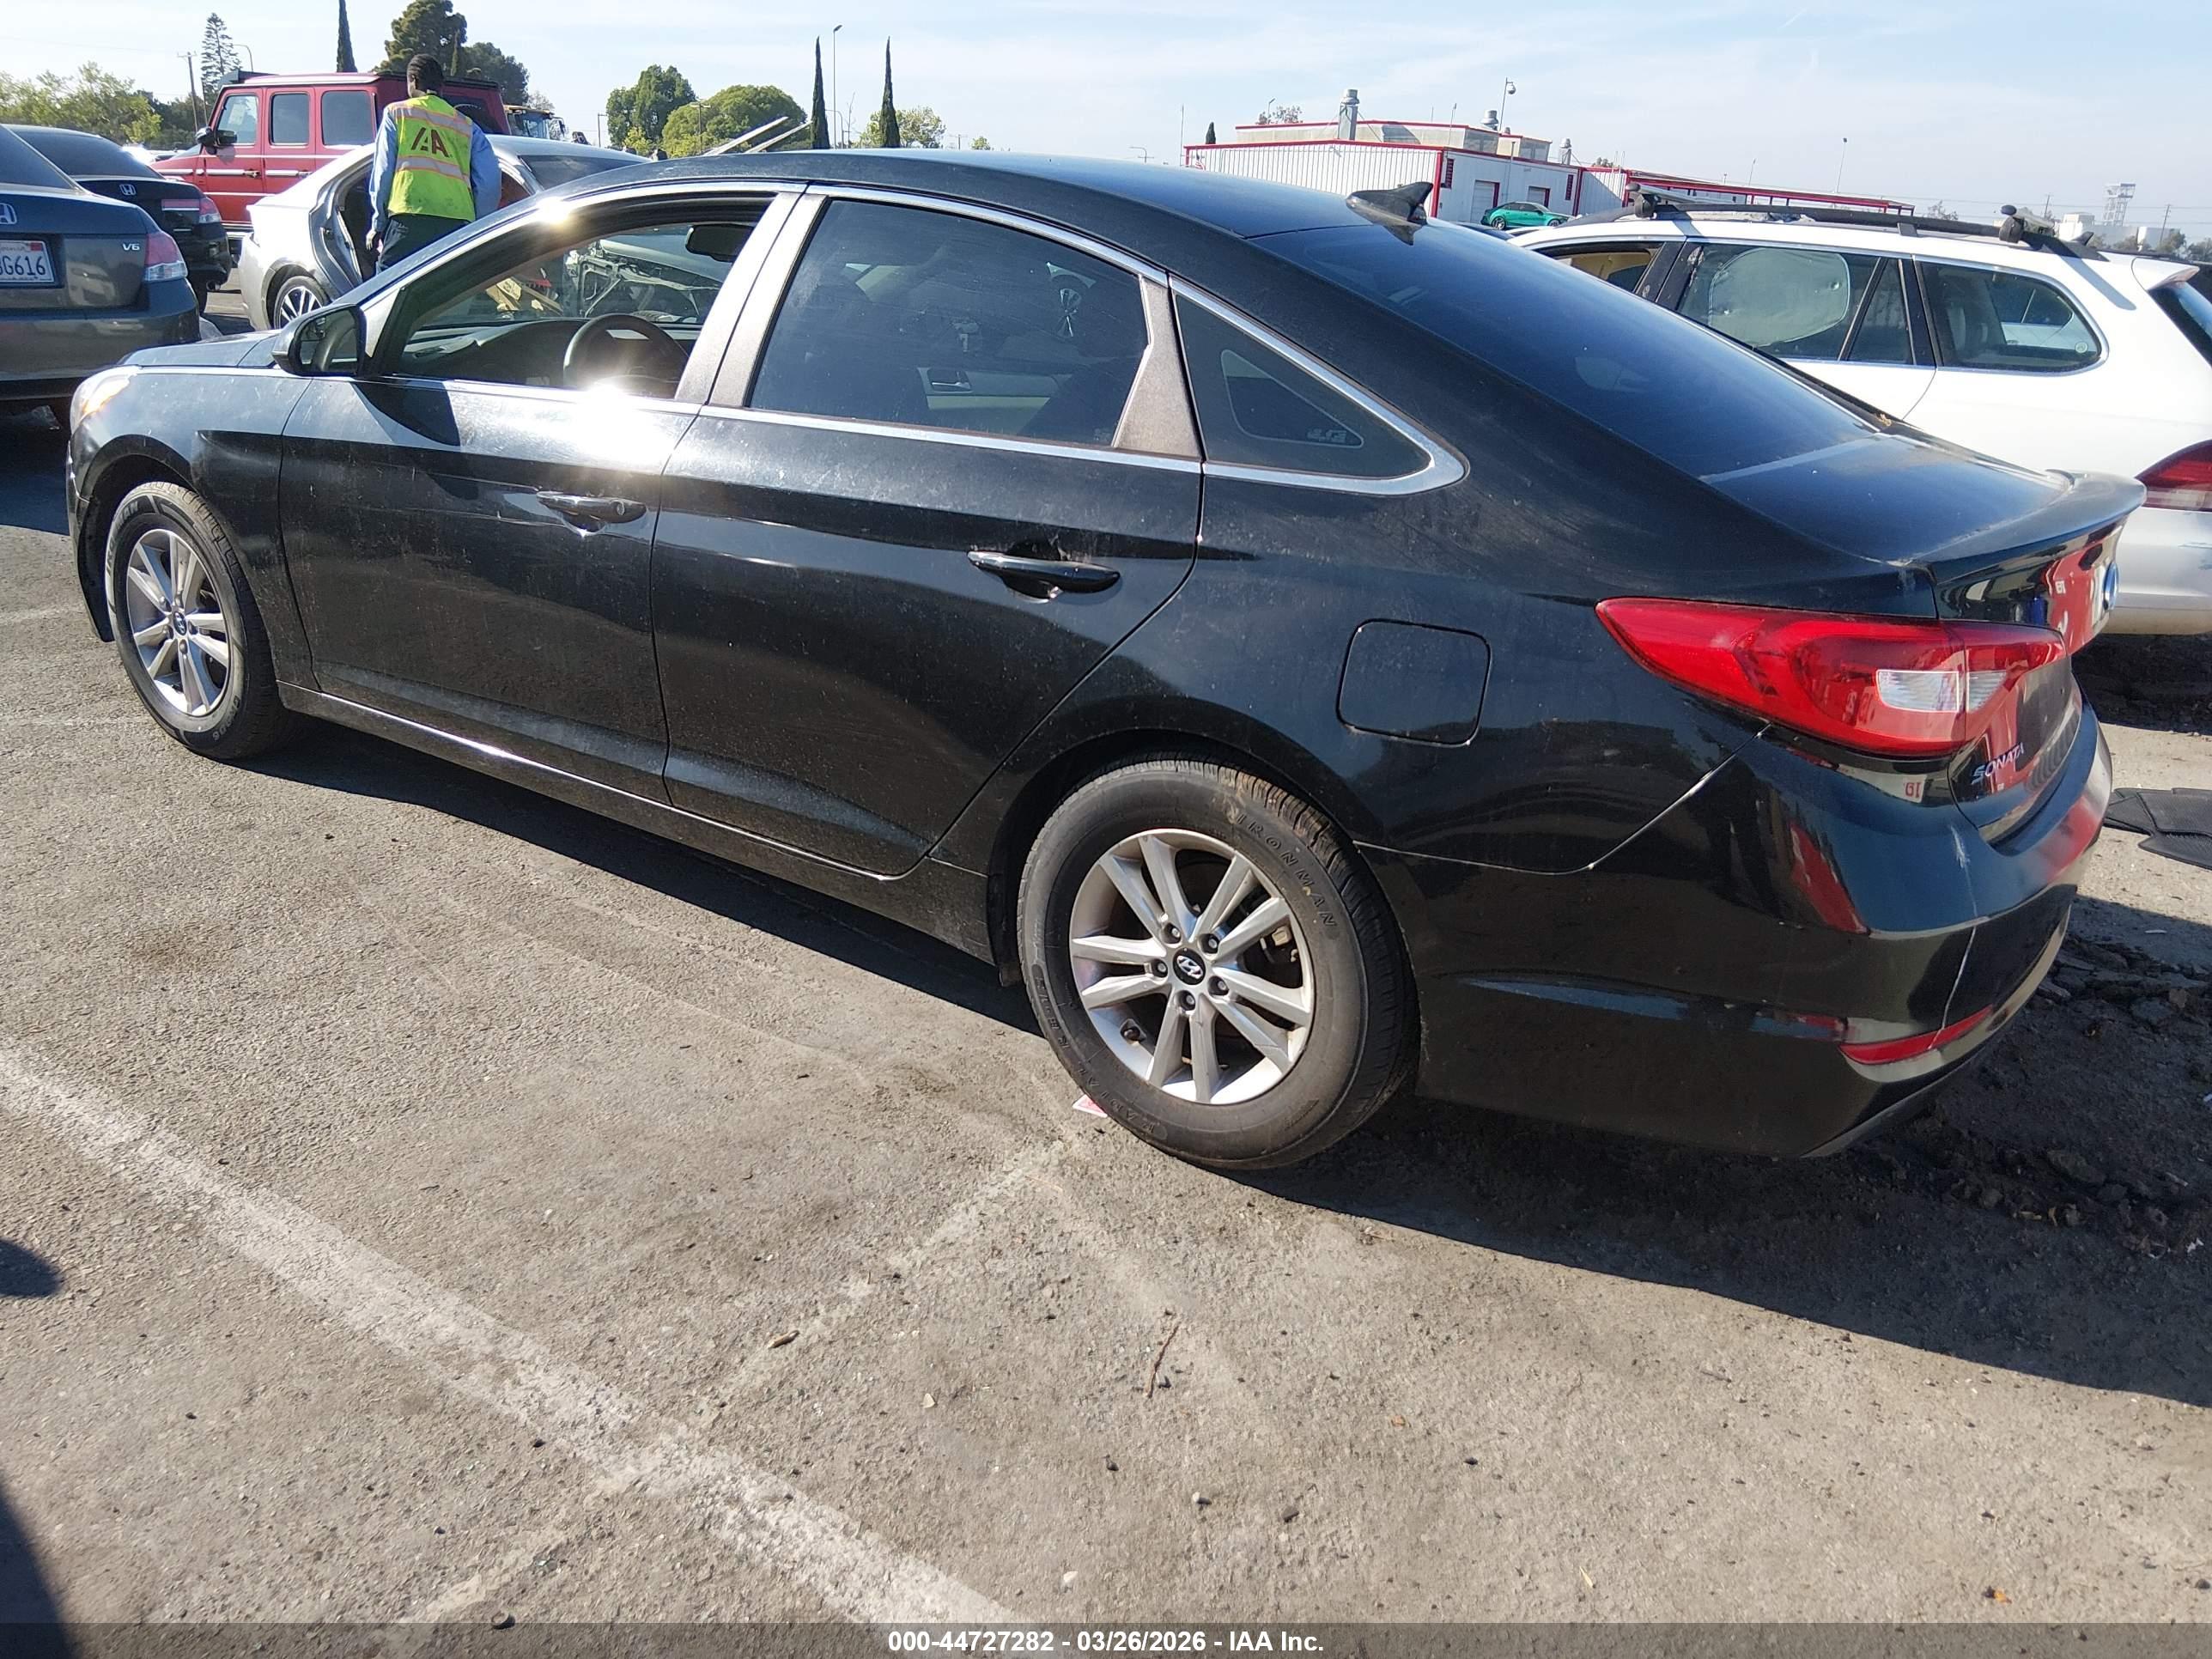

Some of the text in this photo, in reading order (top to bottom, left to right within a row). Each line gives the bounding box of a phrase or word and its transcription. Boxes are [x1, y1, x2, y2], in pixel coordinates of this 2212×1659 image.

[0, 255, 46, 276] G616
[1971, 742, 2025, 785] SONATA
[1237, 814, 1338, 927] IRONMAN
